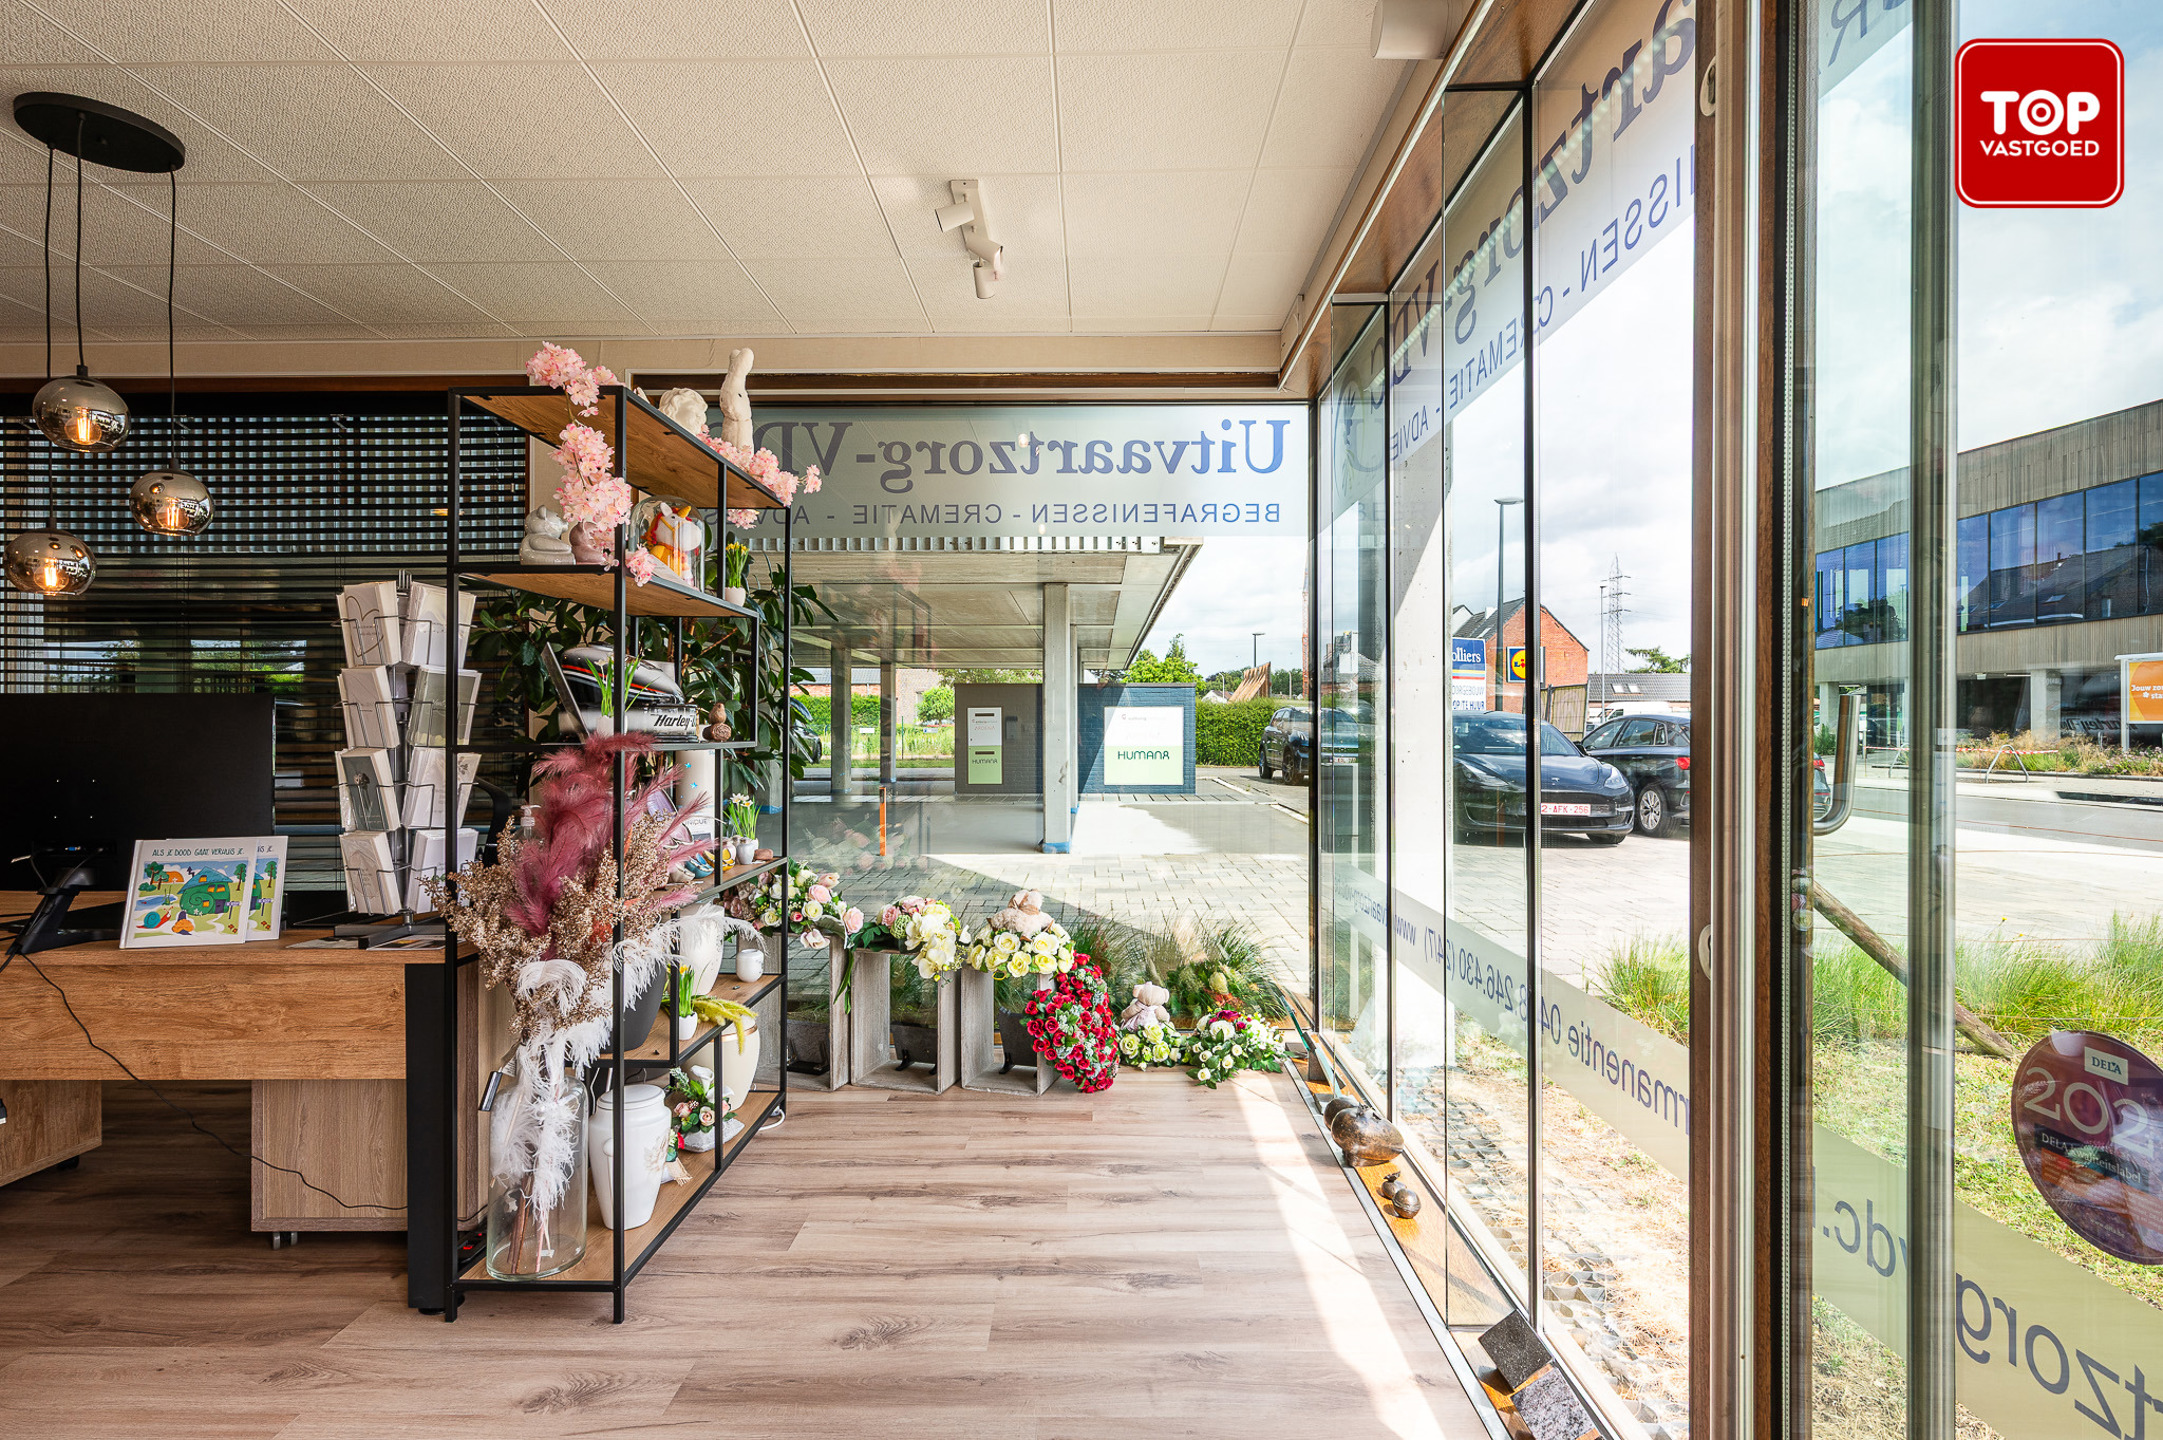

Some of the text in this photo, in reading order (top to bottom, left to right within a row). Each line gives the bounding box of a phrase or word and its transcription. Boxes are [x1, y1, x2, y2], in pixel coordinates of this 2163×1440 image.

[2131, 684, 2152, 693] Jouw
[151, 848, 165, 857] ALS
[174, 848, 192, 856] DOOD
[2091, 1056, 2123, 1076] DELA
